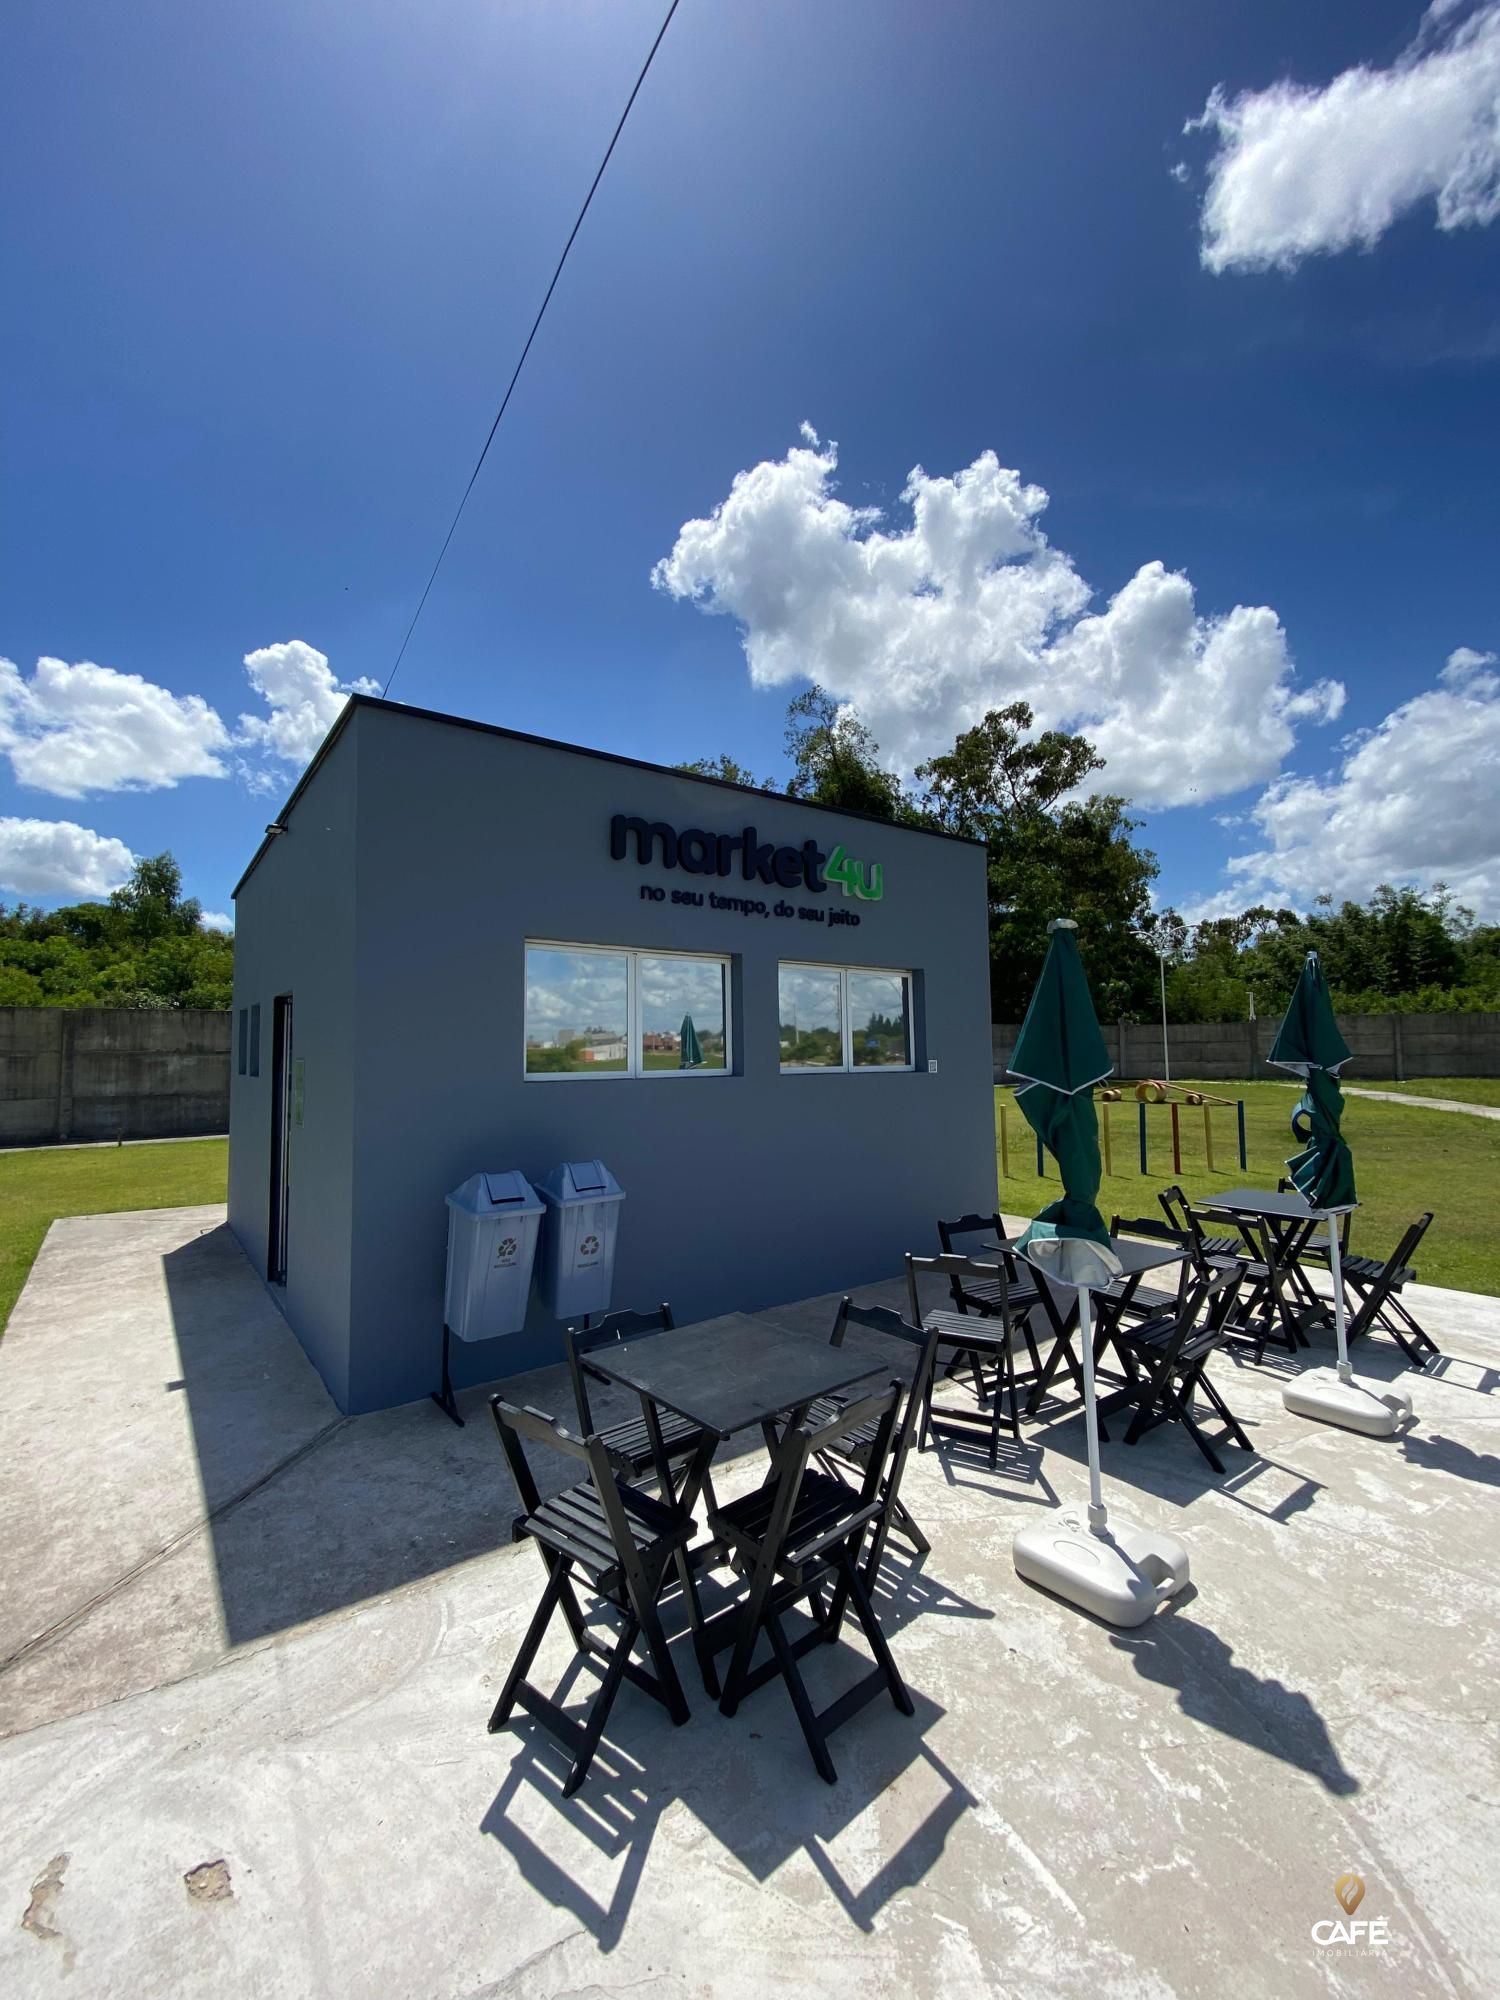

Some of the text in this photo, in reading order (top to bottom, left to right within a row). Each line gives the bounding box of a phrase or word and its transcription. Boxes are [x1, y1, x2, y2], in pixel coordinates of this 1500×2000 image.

[639, 884, 861, 928] no seu tempo, do seu jeito
